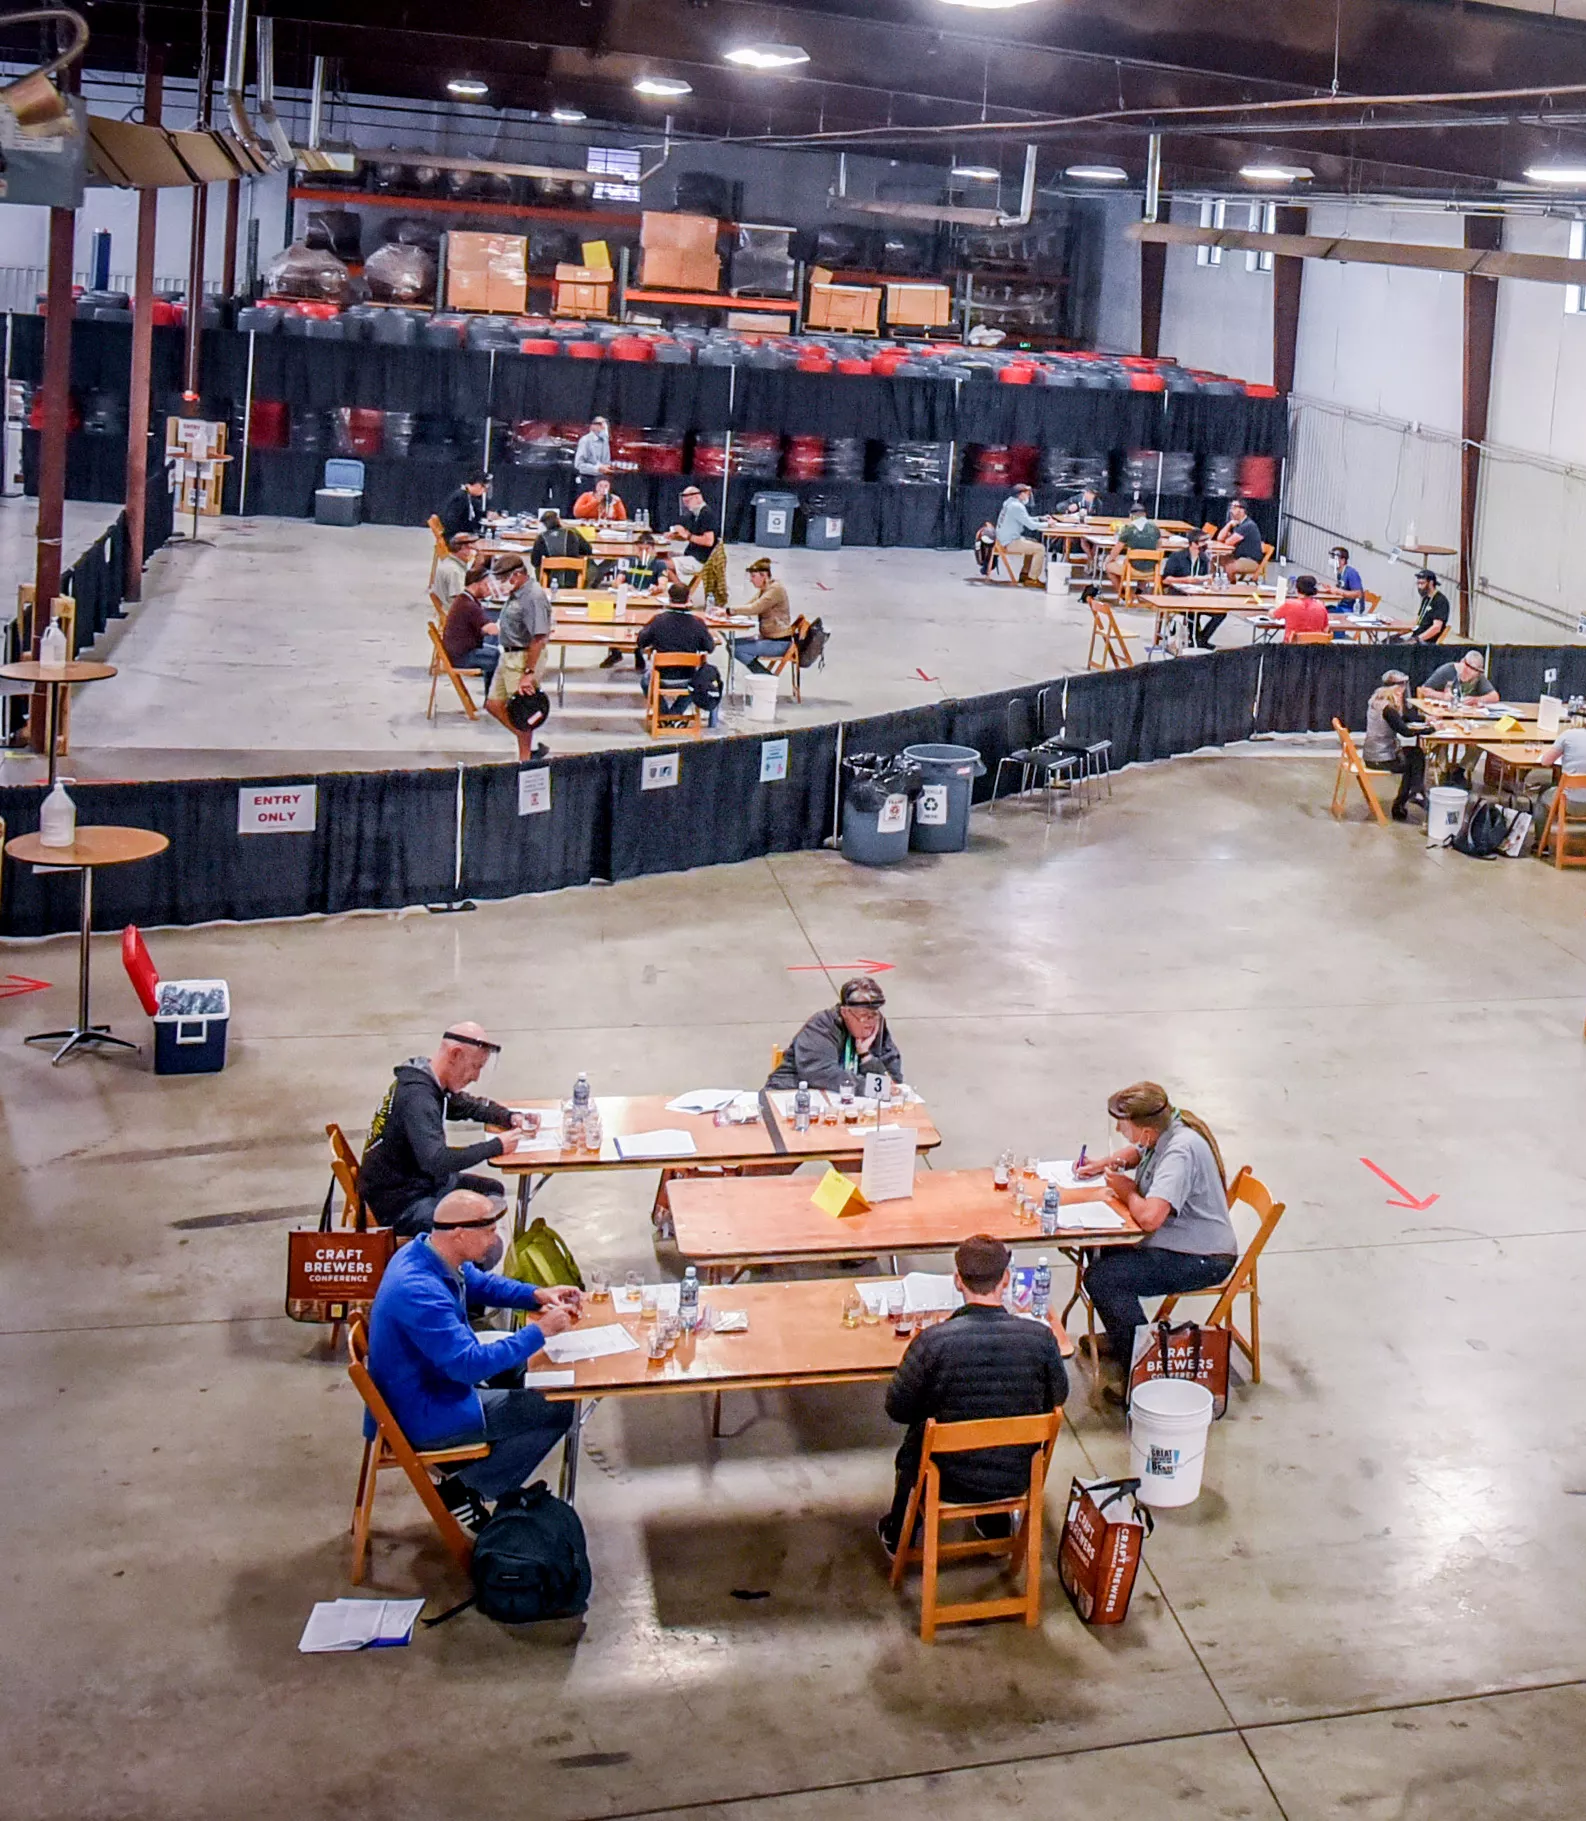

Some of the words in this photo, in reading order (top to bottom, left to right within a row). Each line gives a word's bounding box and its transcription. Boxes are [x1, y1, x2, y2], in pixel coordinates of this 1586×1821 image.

[254, 794, 301, 805] ENTRY
[257, 812, 296, 822] ONLY
[874, 1077, 882, 1093] 3
[315, 1249, 363, 1260] CRAFT
[304, 1262, 373, 1273] BREWERS
[308, 1275, 369, 1283] CONFERENCE
[1158, 1347, 1204, 1358] RAF
[1117, 1528, 1130, 1564] CRAFT
[1105, 1566, 1125, 1613] BREWERS
